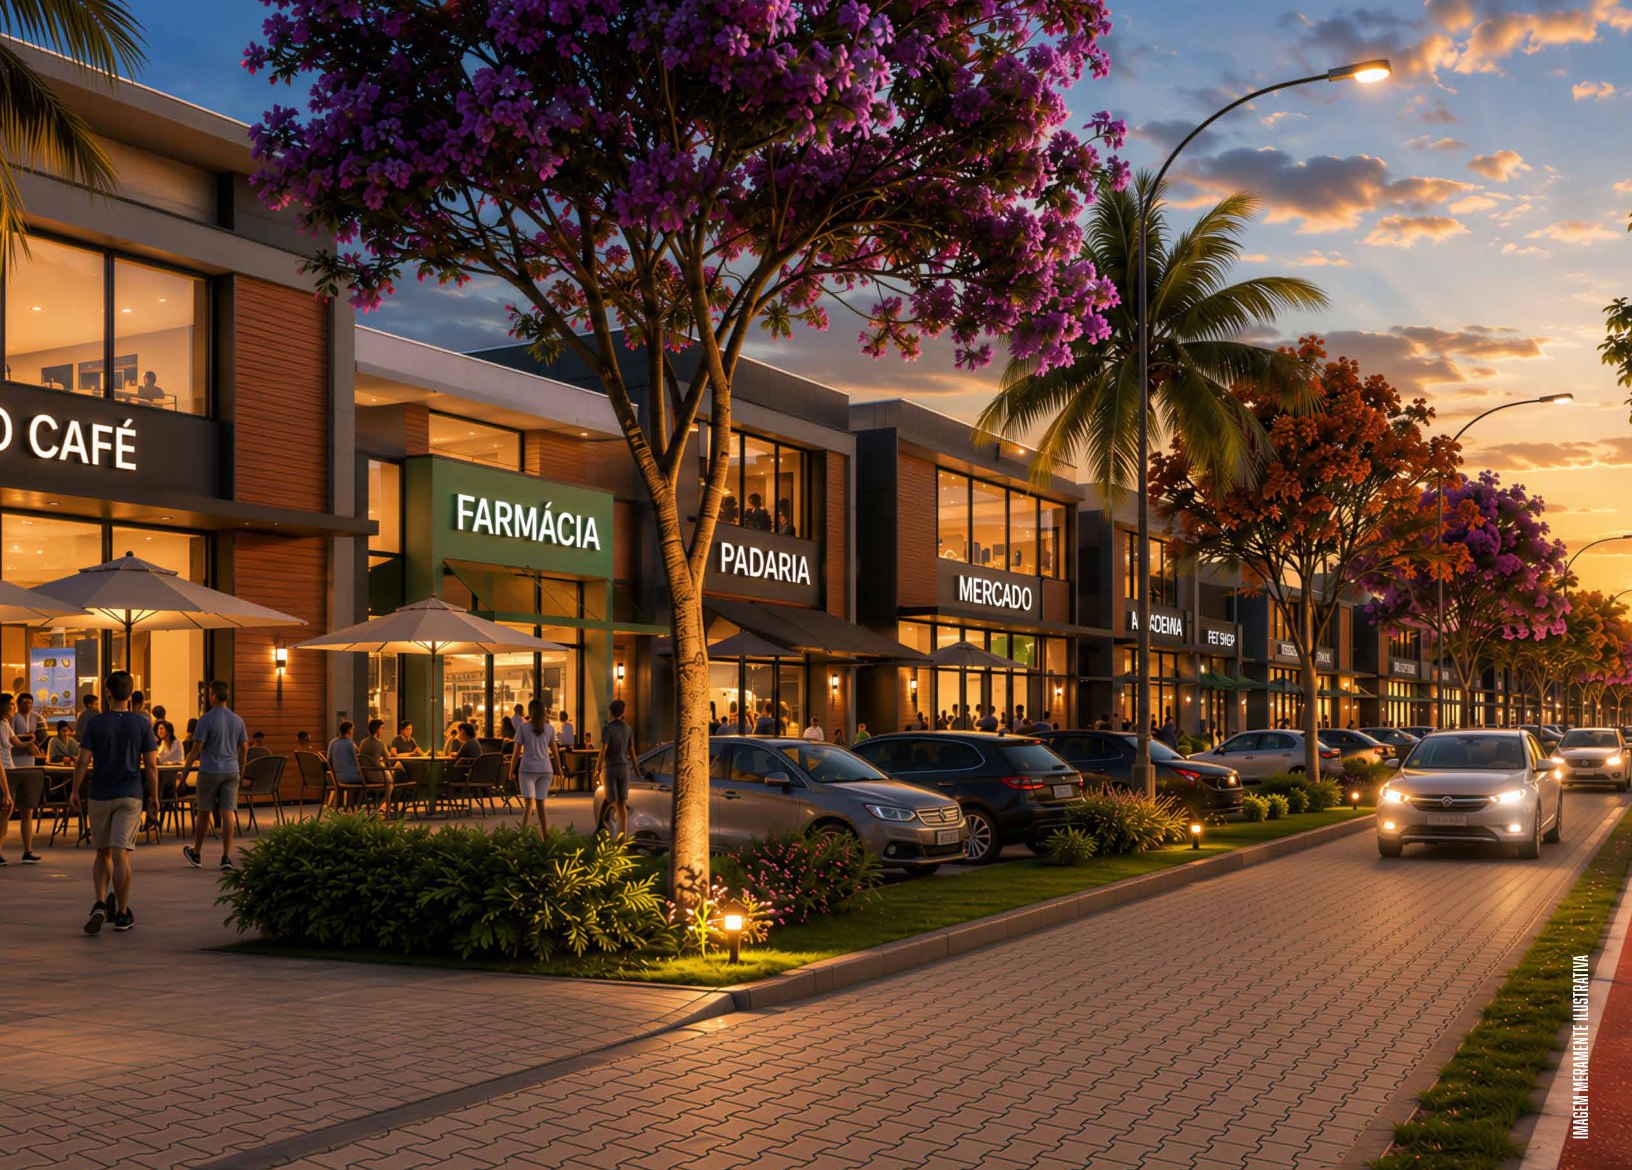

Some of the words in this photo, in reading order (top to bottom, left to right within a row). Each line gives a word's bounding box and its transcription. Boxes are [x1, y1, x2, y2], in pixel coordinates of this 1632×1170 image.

[29, 414, 137, 471] CAFÉ
[457, 493, 601, 551] FARMÁCIA
[721, 541, 811, 585] PADARIA
[959, 574, 1032, 611] MERCADO
